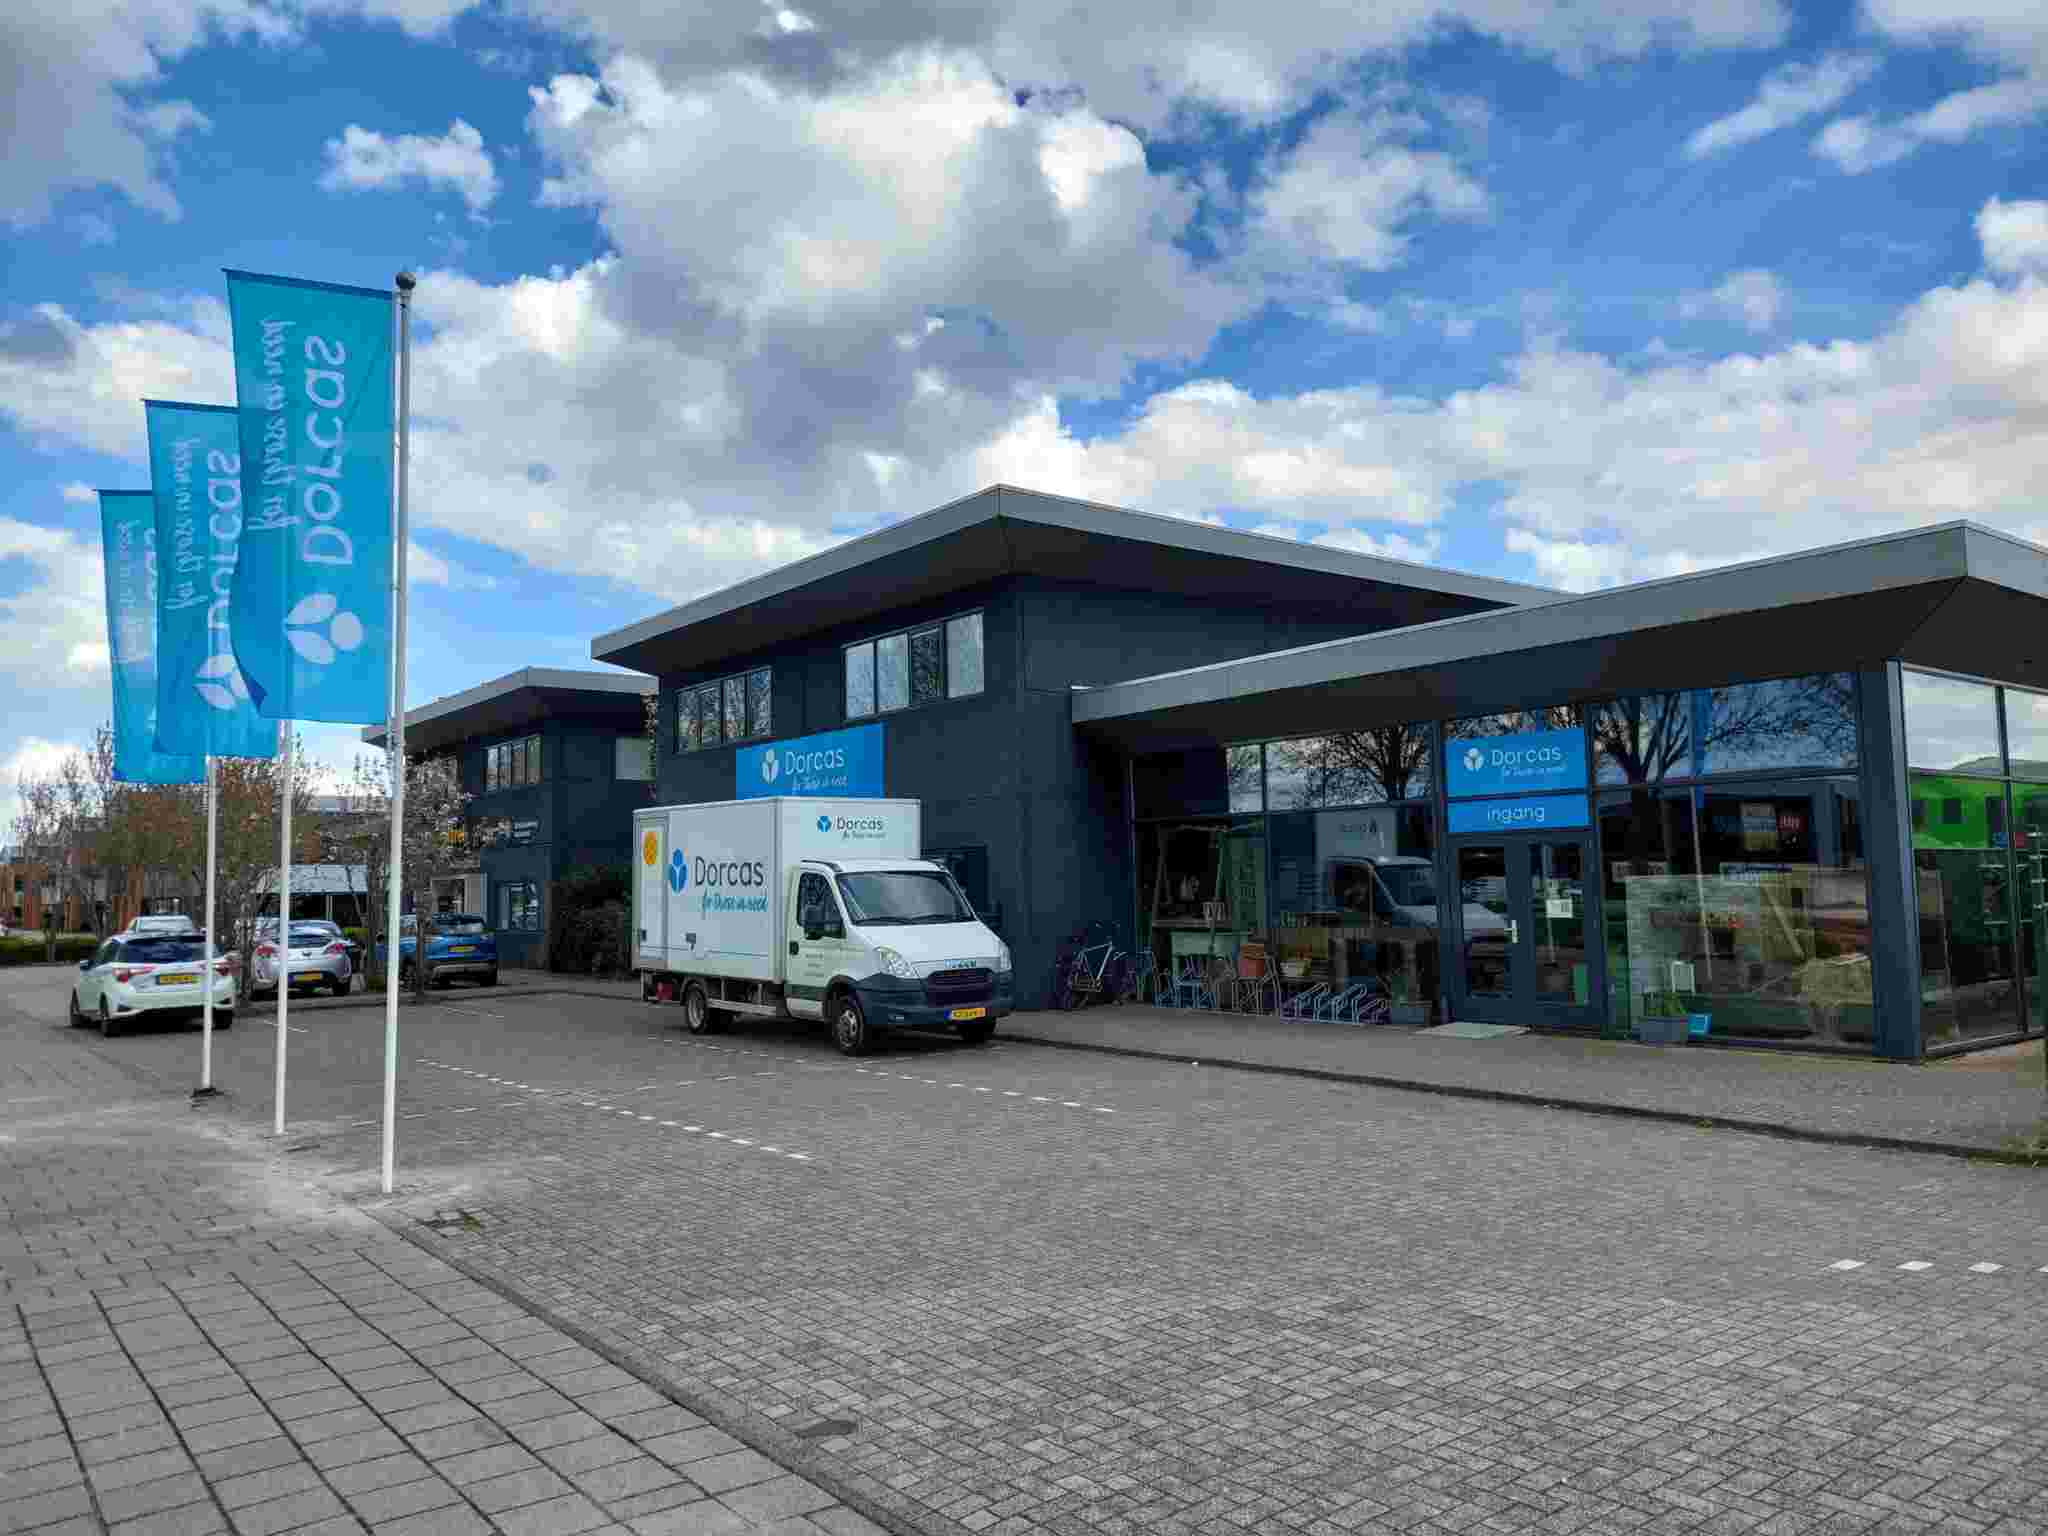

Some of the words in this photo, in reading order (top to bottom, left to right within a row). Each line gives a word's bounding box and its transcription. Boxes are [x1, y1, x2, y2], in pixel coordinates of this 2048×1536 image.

[784, 749, 845, 775] Dorcas
[1490, 746, 1561, 767] Dorcas
[836, 816, 883, 830] Dorcas
[1488, 804, 1545, 825] ingang
[695, 856, 764, 887] Dorcas
